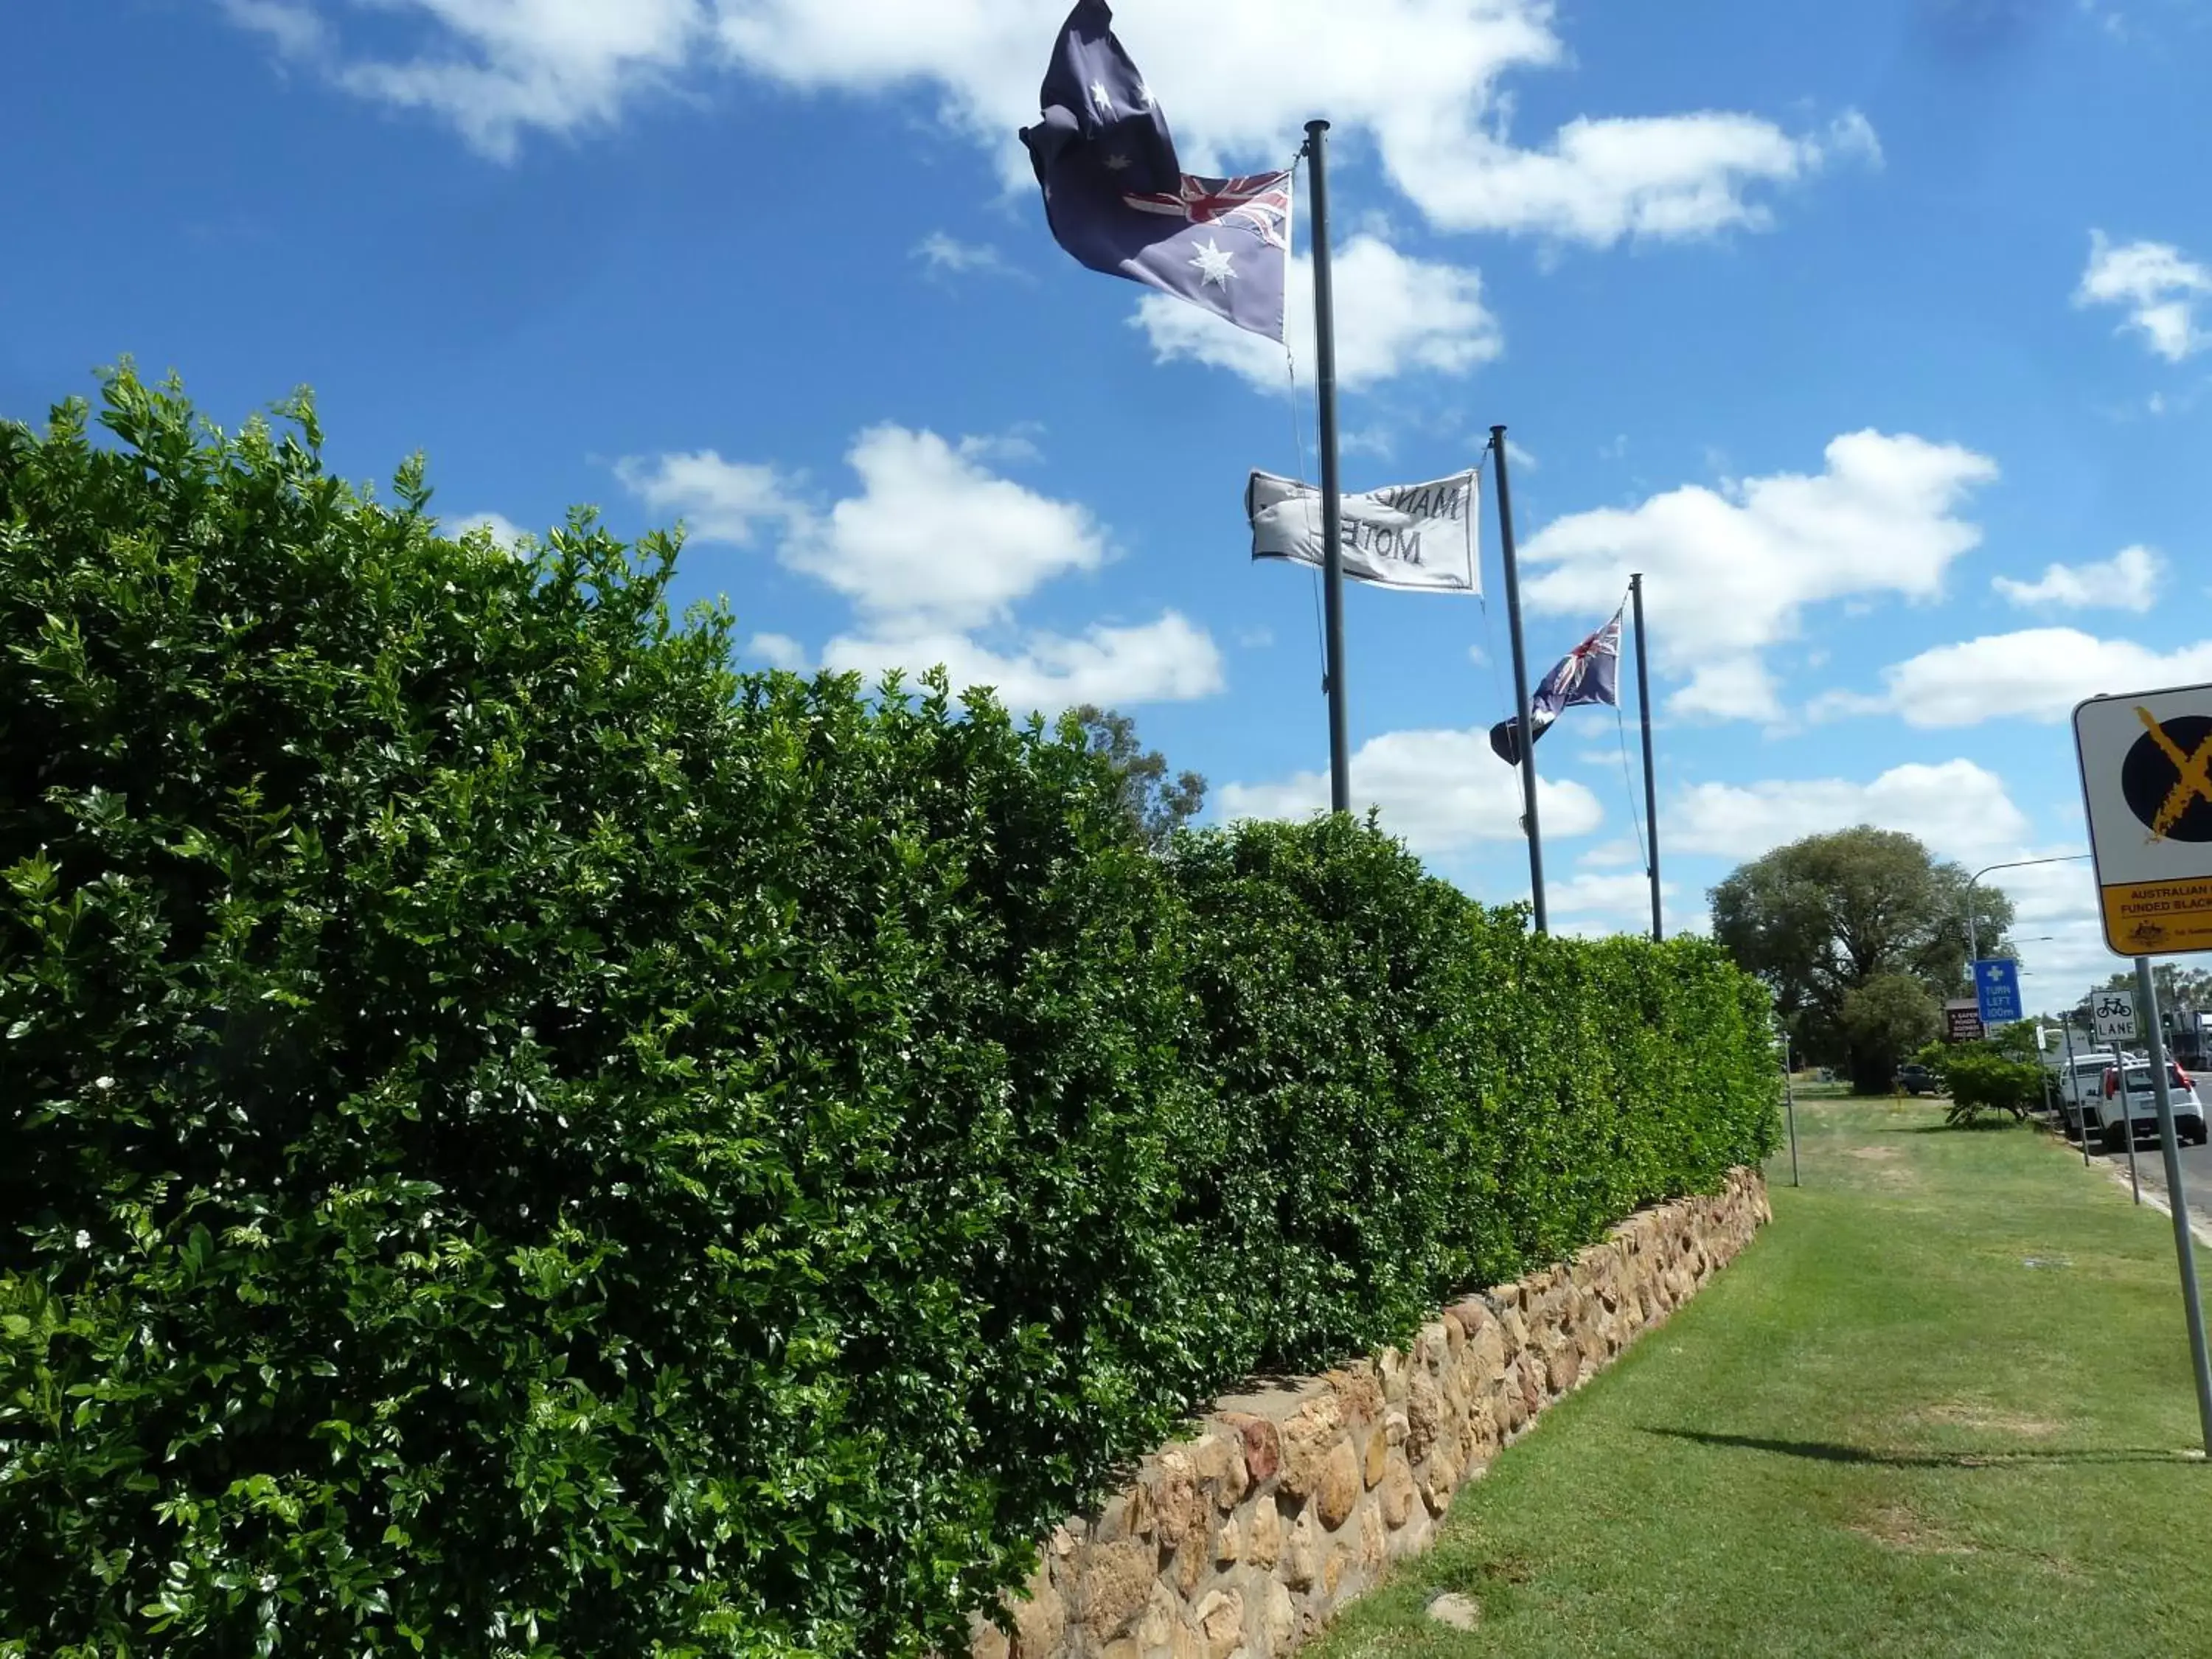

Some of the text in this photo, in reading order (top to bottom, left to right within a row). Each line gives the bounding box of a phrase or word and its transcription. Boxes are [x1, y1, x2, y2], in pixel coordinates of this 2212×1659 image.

[2132, 886, 2207, 898] AUSTRALIAN
[2121, 902, 2170, 913] FUNDED
[1984, 986, 2011, 995] TURN
[1985, 996, 2011, 1006] LEFT
[1987, 1007, 2014, 1018] 100m
[2098, 1021, 2135, 1036] LANE
